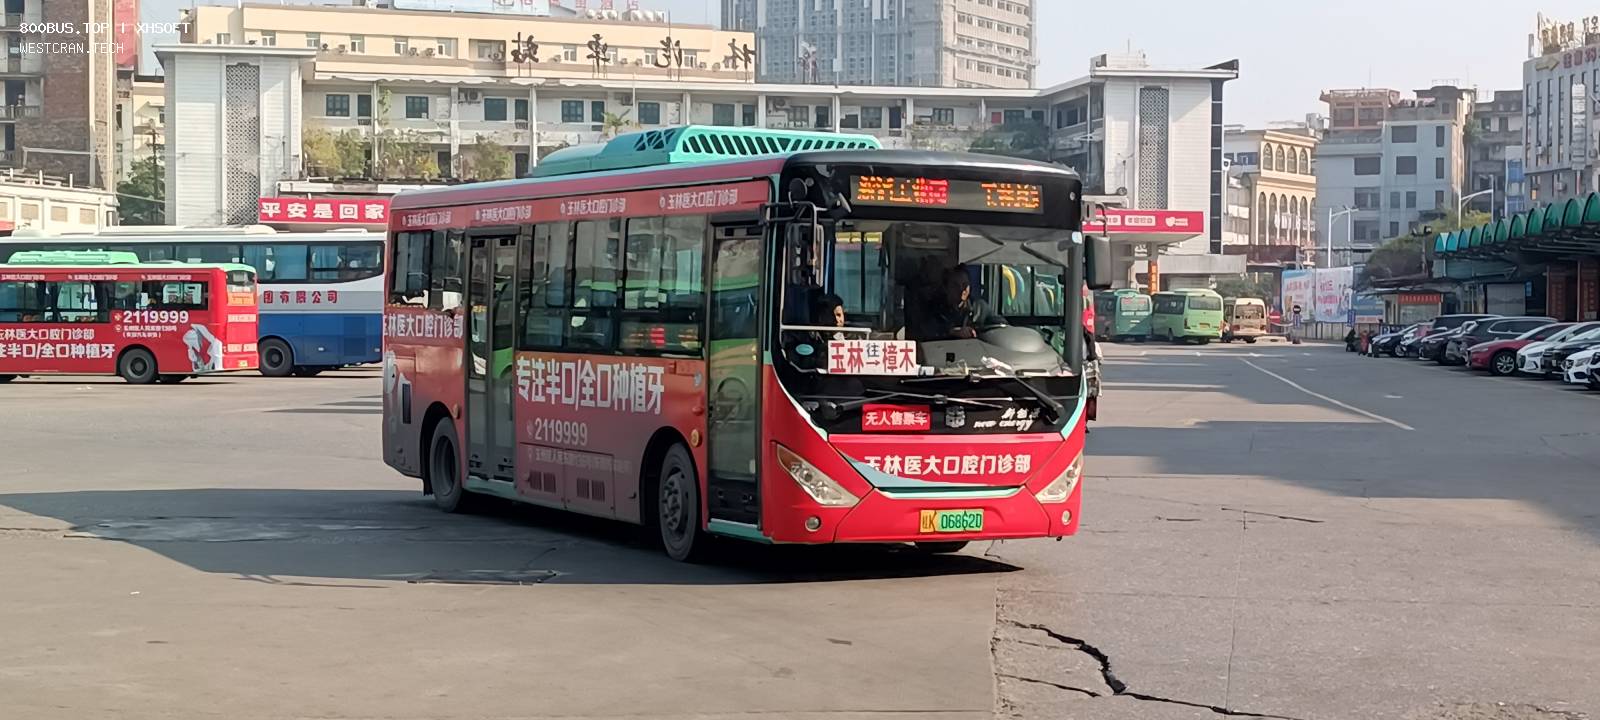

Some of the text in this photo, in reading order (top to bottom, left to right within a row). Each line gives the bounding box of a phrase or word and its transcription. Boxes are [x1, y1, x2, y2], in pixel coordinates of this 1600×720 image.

[261, 202, 385, 219] 平安是回家
[123, 310, 189, 324] 2119999
[516, 357, 665, 415] 专注半口/全口种植牙
[864, 410, 928, 426] 无人售票车
[534, 417, 588, 446] 2119999
[864, 454, 1032, 476] 玉林医大口腔门诊部
[941, 513, 982, 530] 06862D
